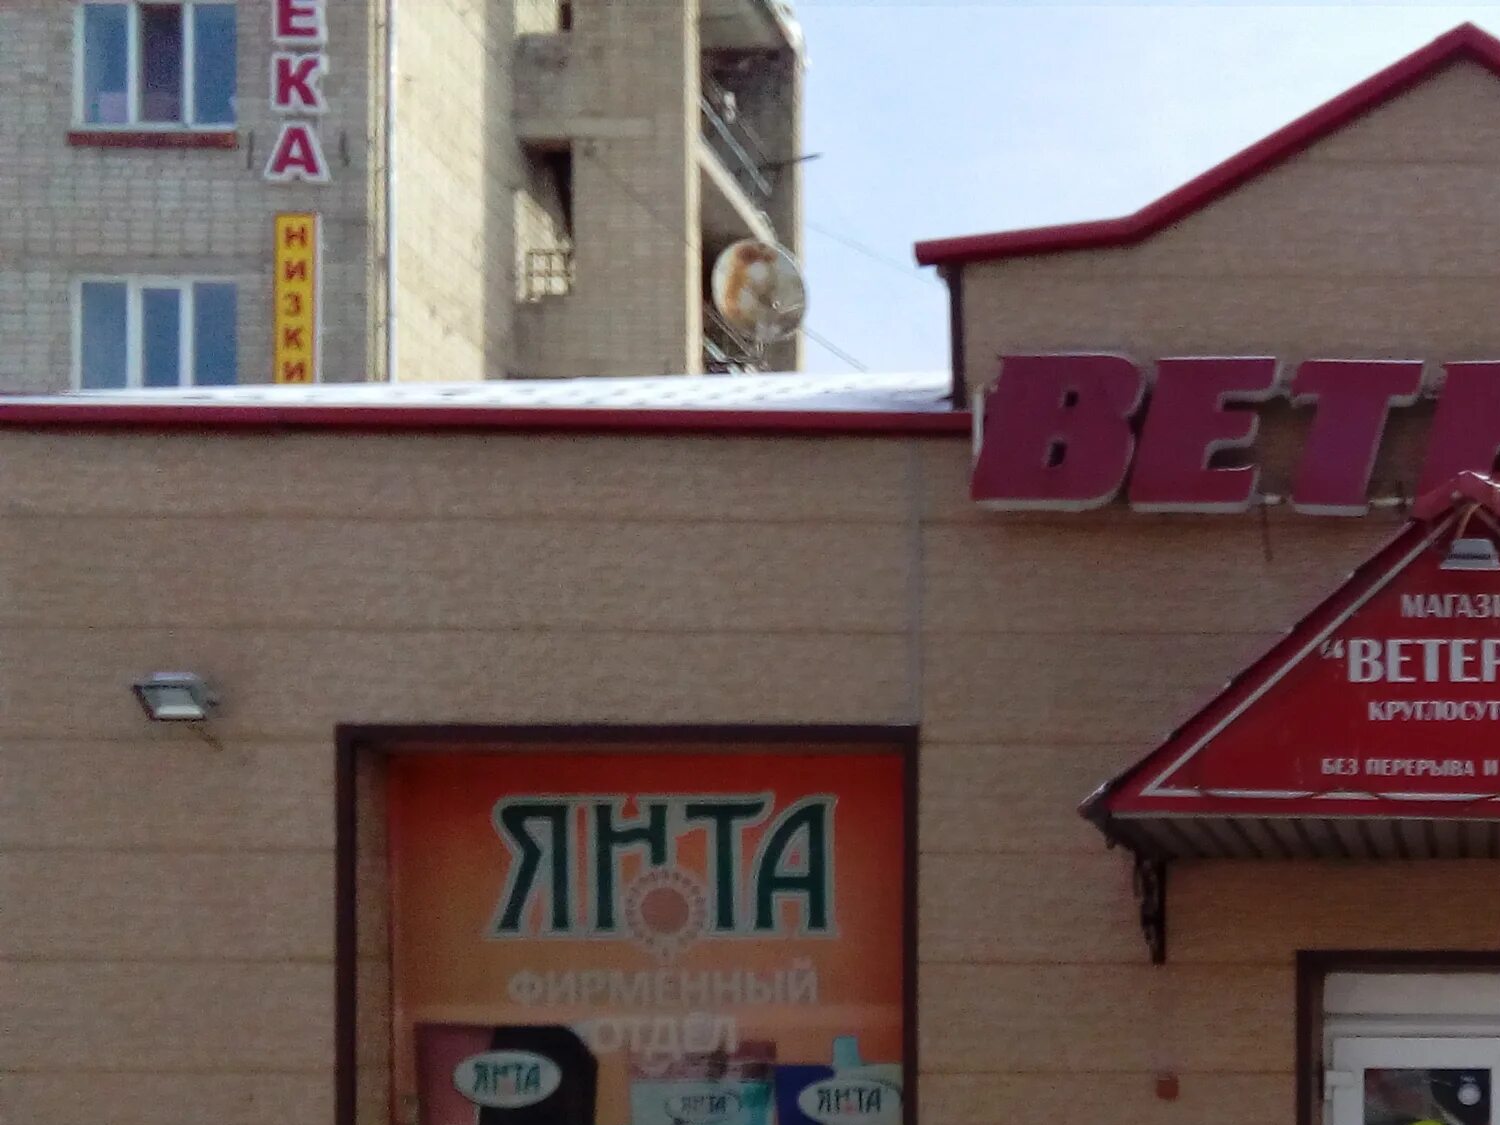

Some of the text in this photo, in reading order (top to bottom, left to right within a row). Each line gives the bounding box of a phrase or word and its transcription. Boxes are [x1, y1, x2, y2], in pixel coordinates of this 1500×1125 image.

[268, 0, 325, 178] ЕКА
[282, 224, 309, 382] НИЗКИ
[1321, 758, 1359, 776] БЕЗ
[1365, 759, 1476, 777] ПЕРЕРЫВА
[1482, 760, 1499, 777] И
[488, 796, 836, 936] ЯНТА
[507, 957, 818, 1005] ФИРМЕННЫЙ
